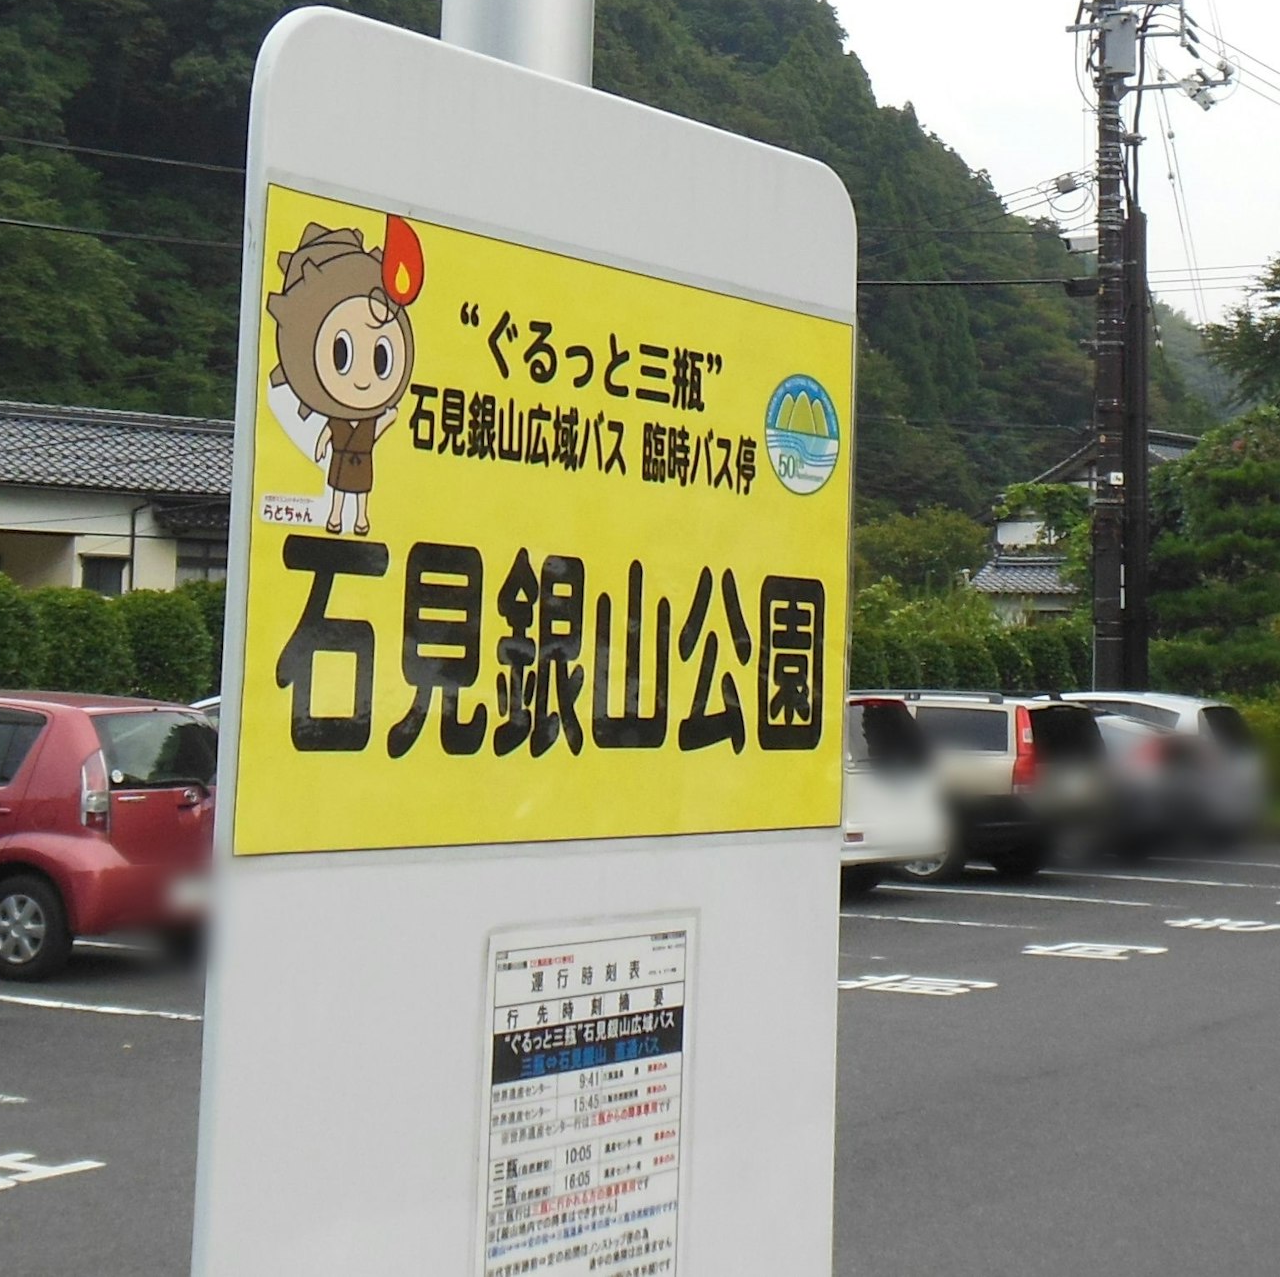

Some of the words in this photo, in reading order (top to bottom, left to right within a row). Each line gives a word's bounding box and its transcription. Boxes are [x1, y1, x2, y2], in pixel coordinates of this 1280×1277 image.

[409, 383, 628, 477] 石見銀山広域バス
[642, 430, 757, 496] 臨時バス停
[263, 504, 313, 523] らとちゃん
[275, 532, 826, 760] 石見銀山公園
[531, 960, 641, 992] 運行時刻表
[506, 1004, 549, 1030] 行先
[561, 996, 603, 1021] 時刻
[579, 1072, 601, 1090] 9:41
[572, 1095, 601, 1113] 15:45
[563, 1144, 593, 1166] 10:05
